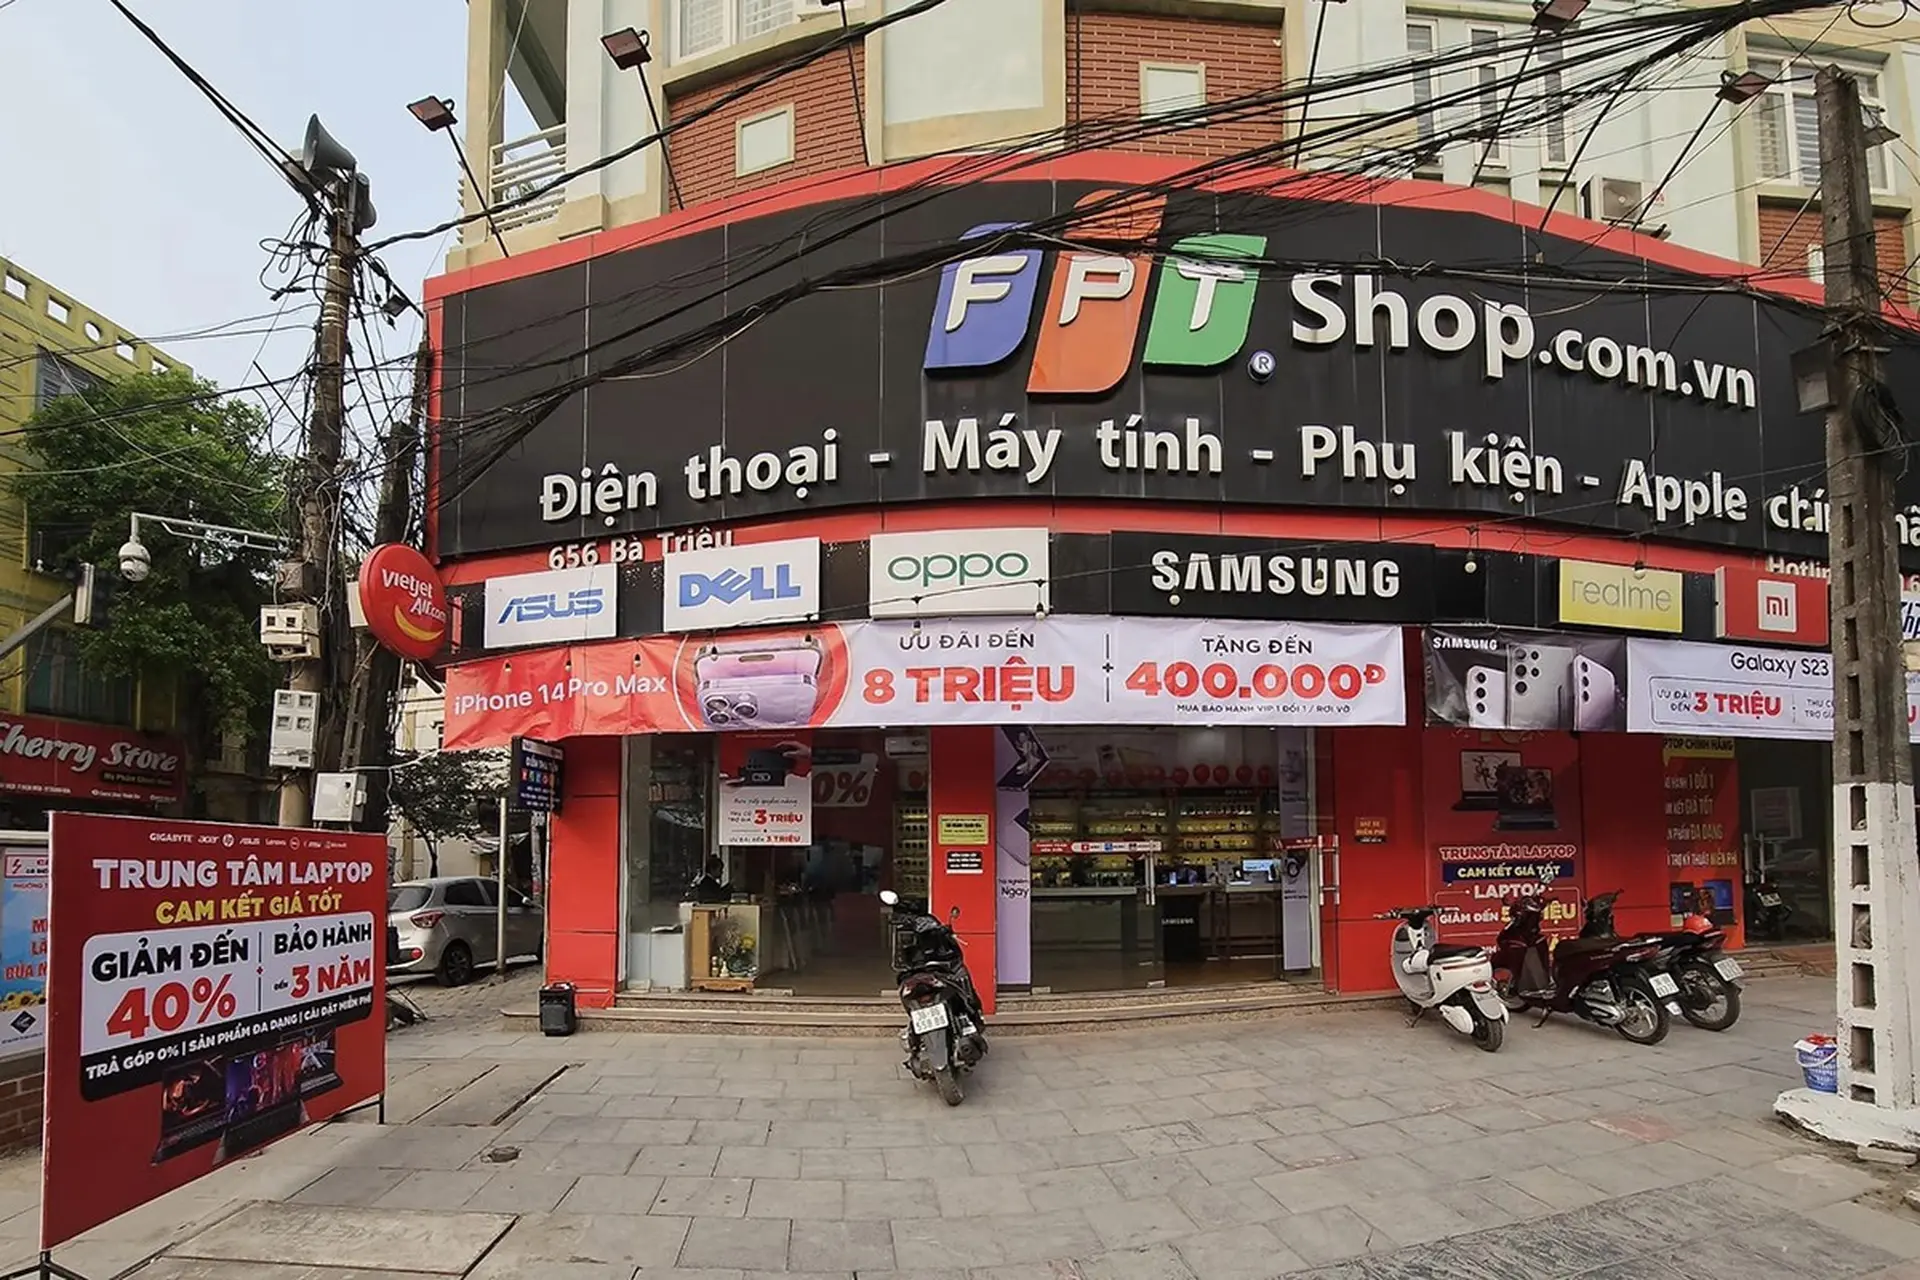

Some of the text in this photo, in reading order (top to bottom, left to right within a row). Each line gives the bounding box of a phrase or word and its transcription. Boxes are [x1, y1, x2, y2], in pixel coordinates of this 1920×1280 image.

[1291, 272, 1756, 408] Shop.com.vn
[539, 466, 658, 527] Điện
[685, 428, 840, 499] thoại
[922, 413, 1062, 485] Máy
[1096, 413, 1223, 474] tính
[1300, 424, 1417, 495] Phụ
[1449, 431, 1564, 503] kiện
[1620, 459, 1748, 526] Apple
[1769, 484, 1831, 534] chí
[548, 541, 600, 571] 656
[610, 534, 644, 563] Bà
[887, 551, 1030, 588] oppo
[678, 564, 802, 609] DELL
[1151, 550, 1401, 598] SAMSUNG
[496, 588, 604, 625] ASUS
[1570, 579, 1672, 614] realme
[938, 630, 980, 650] ĐÃI
[987, 630, 1035, 650] ĐẾN
[1201, 634, 1313, 656] TẶNG ĐẾN
[1432, 636, 1498, 651] SAMSUNG
[862, 656, 1076, 711] 8 TRIỆU
[1730, 651, 1830, 680] Galaxy S23
[454, 672, 667, 716] iPhone 14 Pro Max
[1177, 703, 1200, 713] MUA
[1693, 690, 1782, 720] 3 TRIỆU
[101, 741, 179, 772] Store
[754, 808, 804, 825] 3 TRIỆU
[149, 832, 194, 844] GIGABYTE
[1438, 842, 1577, 861] TRUNG TÂM LAPTOP
[92, 853, 374, 890] TRUNG TÂM LAPTOP
[1457, 860, 1561, 878] CAM KẾT GIÁ TỐT
[155, 886, 343, 924] CAM KẾT GIÁ TỐT
[1001, 886, 1030, 899] Ngay
[1438, 908, 1472, 925] GIẢM
[1473, 907, 1499, 923] ĐẾN
[91, 936, 182, 982] GIẢM
[189, 929, 249, 969] ĐẾN
[274, 920, 373, 955] BẢO HÀNH
[290, 964, 310, 999] 3
[317, 953, 371, 993] NĂM
[105, 972, 237, 1039] 40%
[85, 1054, 121, 1080] TRẢ
[122, 1049, 155, 1070] GÓP
[157, 1044, 180, 1061] 0%
[188, 1033, 216, 1053] SẢN
[216, 1021, 251, 1045] PHẨM
[252, 1020, 269, 1035] ĐA
[270, 1011, 298, 1031] DẠNG
